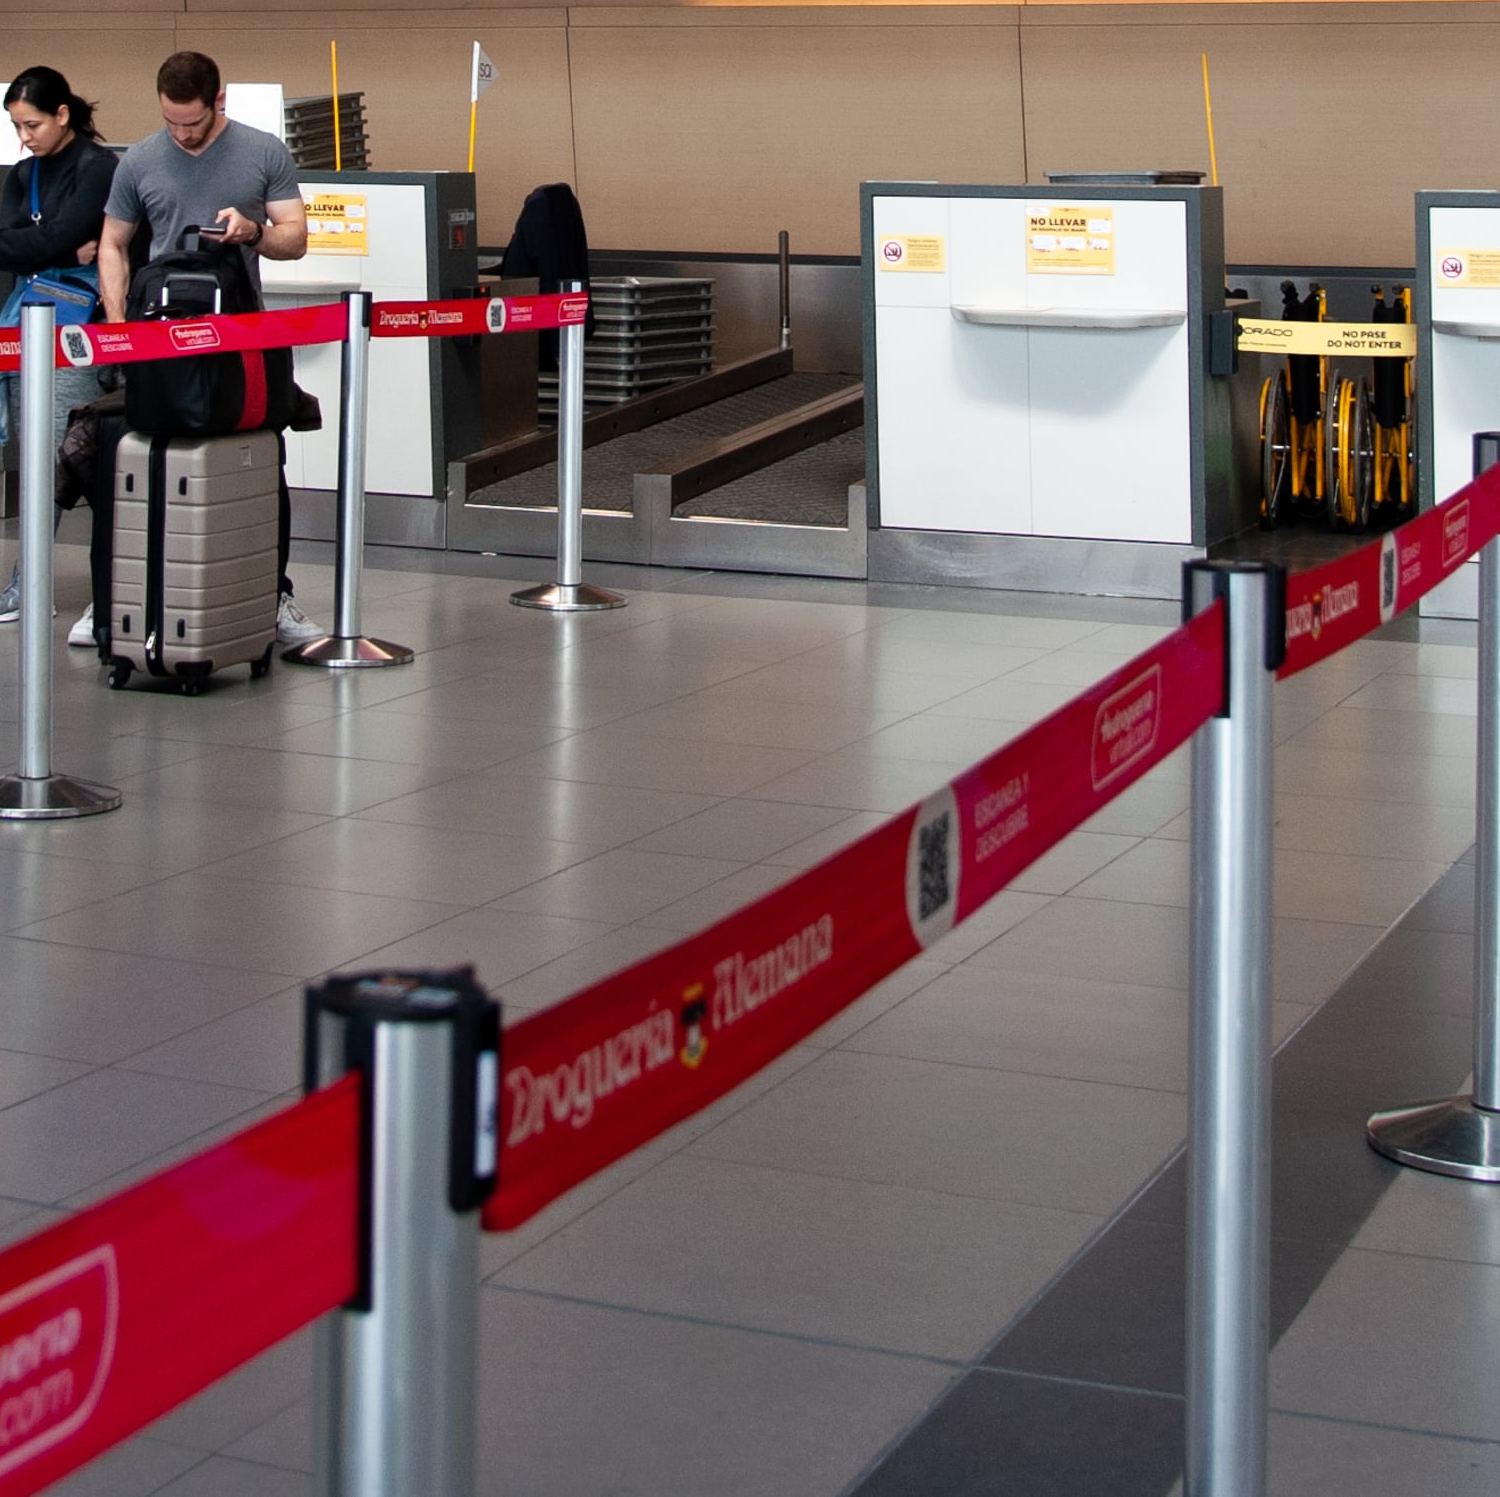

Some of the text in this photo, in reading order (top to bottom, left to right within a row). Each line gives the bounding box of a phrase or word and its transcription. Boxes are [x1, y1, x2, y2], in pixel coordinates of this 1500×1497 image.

[1049, 218, 1087, 226] LLEVAR
[1361, 331, 1387, 339] PASE
[1327, 340, 1401, 349] DO NOT ENTER
[506, 913, 833, 1147] Droguería Alemana
